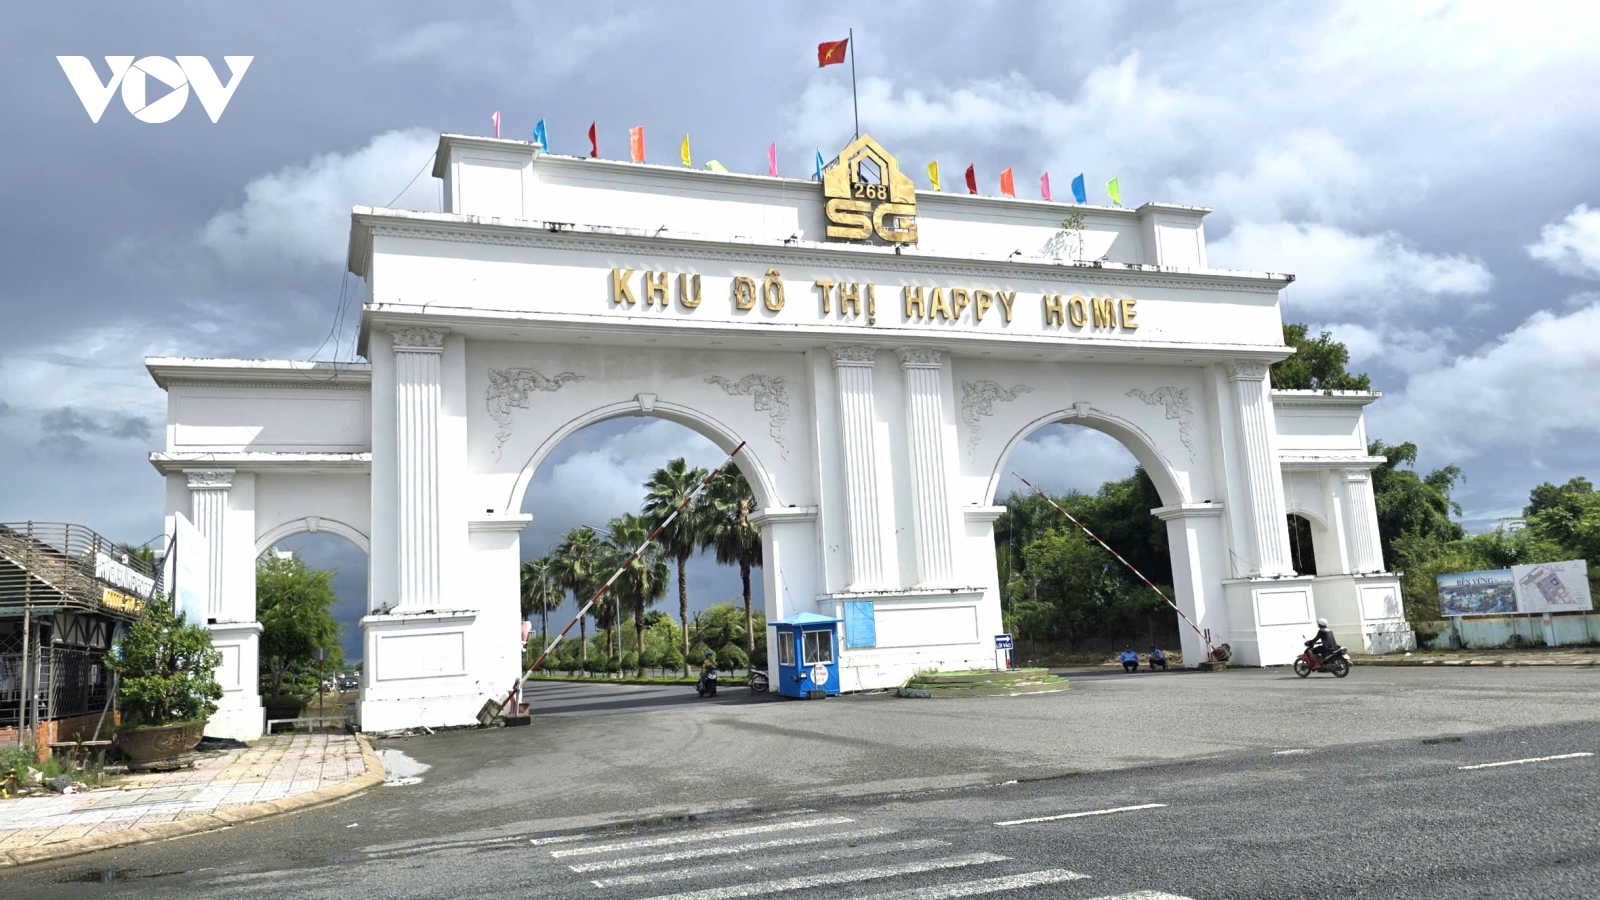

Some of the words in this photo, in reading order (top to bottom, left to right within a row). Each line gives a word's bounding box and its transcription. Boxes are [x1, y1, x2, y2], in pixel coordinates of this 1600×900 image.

[854, 183, 888, 200] 268
[826, 198, 918, 244] SG
[612, 268, 701, 308] KHU
[734, 268, 785, 311] ĐÔ
[815, 280, 875, 324] THỊ
[904, 285, 1016, 322] HAPPY
[1044, 294, 1139, 329] HOME
